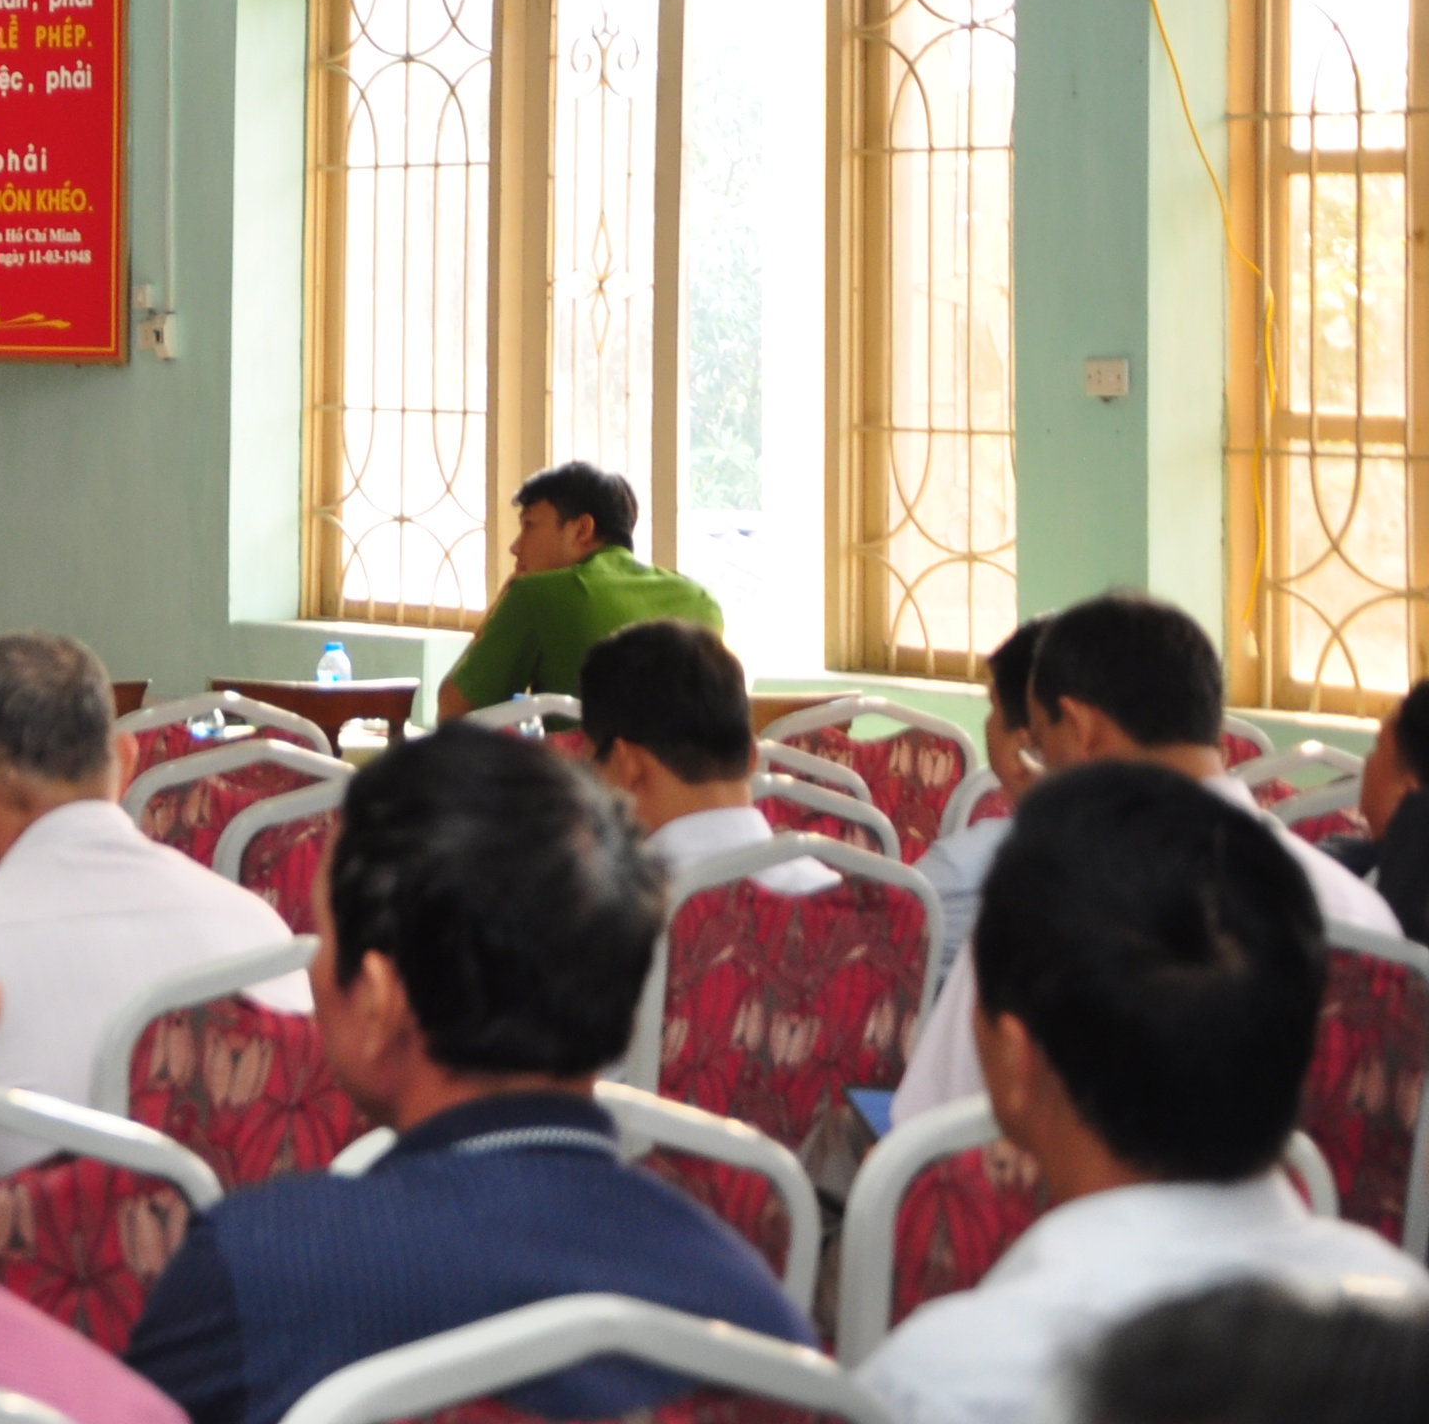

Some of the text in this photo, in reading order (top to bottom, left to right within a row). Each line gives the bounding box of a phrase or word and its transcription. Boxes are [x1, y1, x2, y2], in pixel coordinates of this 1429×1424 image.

[35, 17, 92, 48] PHÉP.
[46, 60, 92, 94] phải
[36, 181, 93, 212] KHÉO.
[25, 228, 46, 242] Chí
[49, 228, 81, 242] Minh
[28, 249, 91, 264] 11-03-1948
